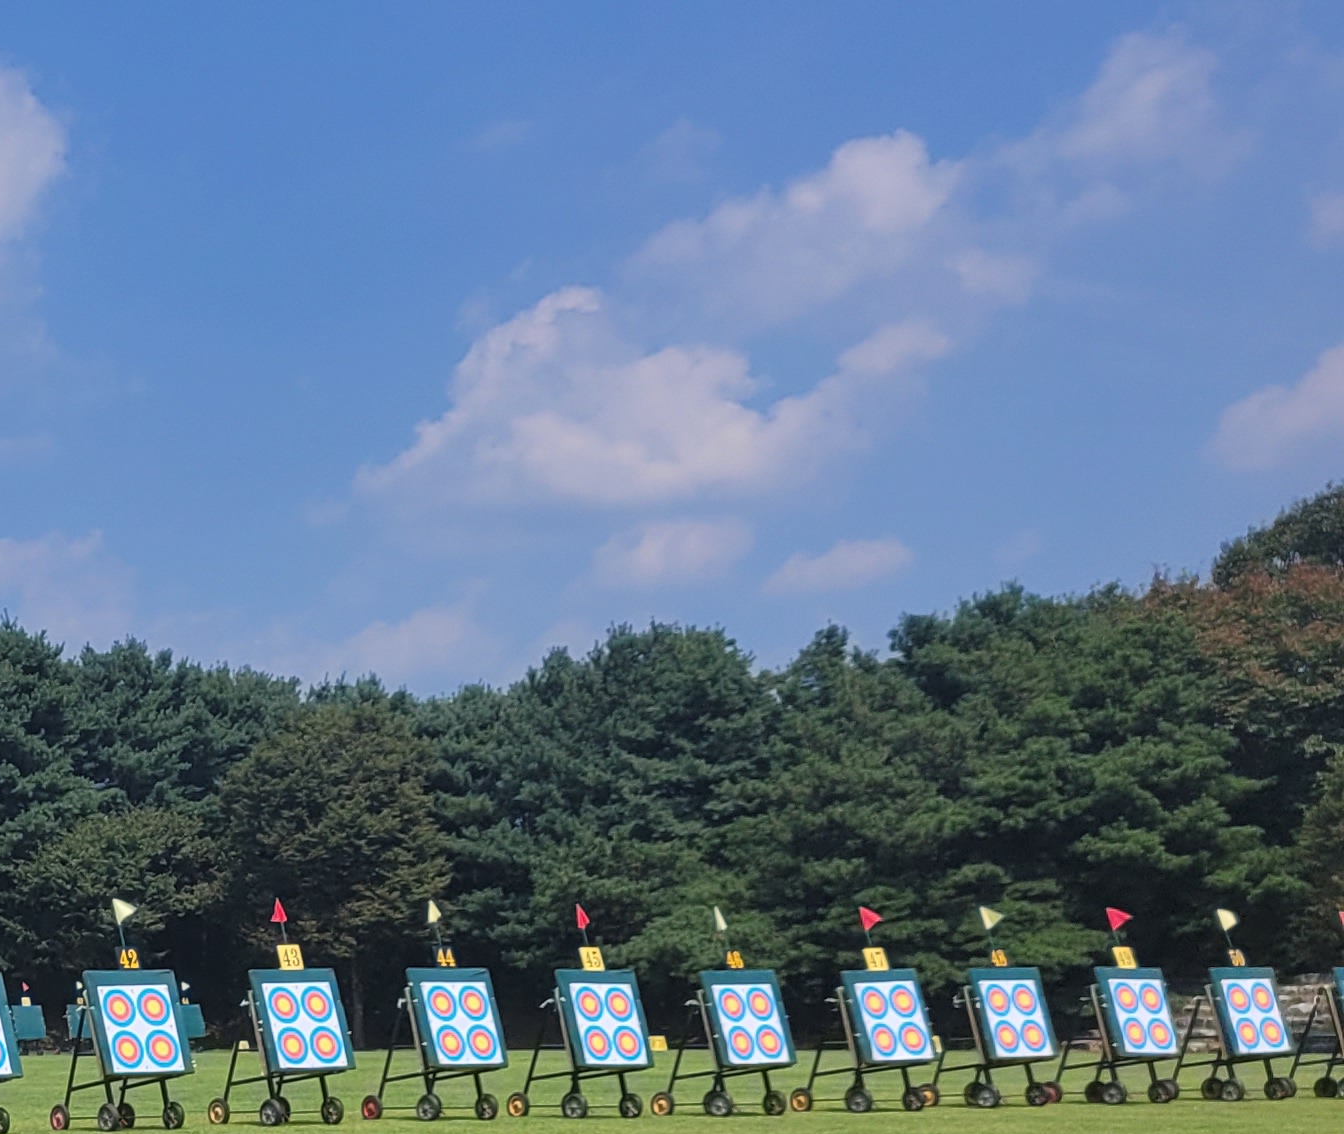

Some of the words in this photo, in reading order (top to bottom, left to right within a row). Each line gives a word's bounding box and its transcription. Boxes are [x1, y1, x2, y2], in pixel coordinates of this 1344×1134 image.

[119, 949, 140, 968] 42
[283, 948, 300, 967] 43
[437, 948, 456, 967] 44
[585, 951, 601, 968] 45
[870, 951, 884, 968] 47
